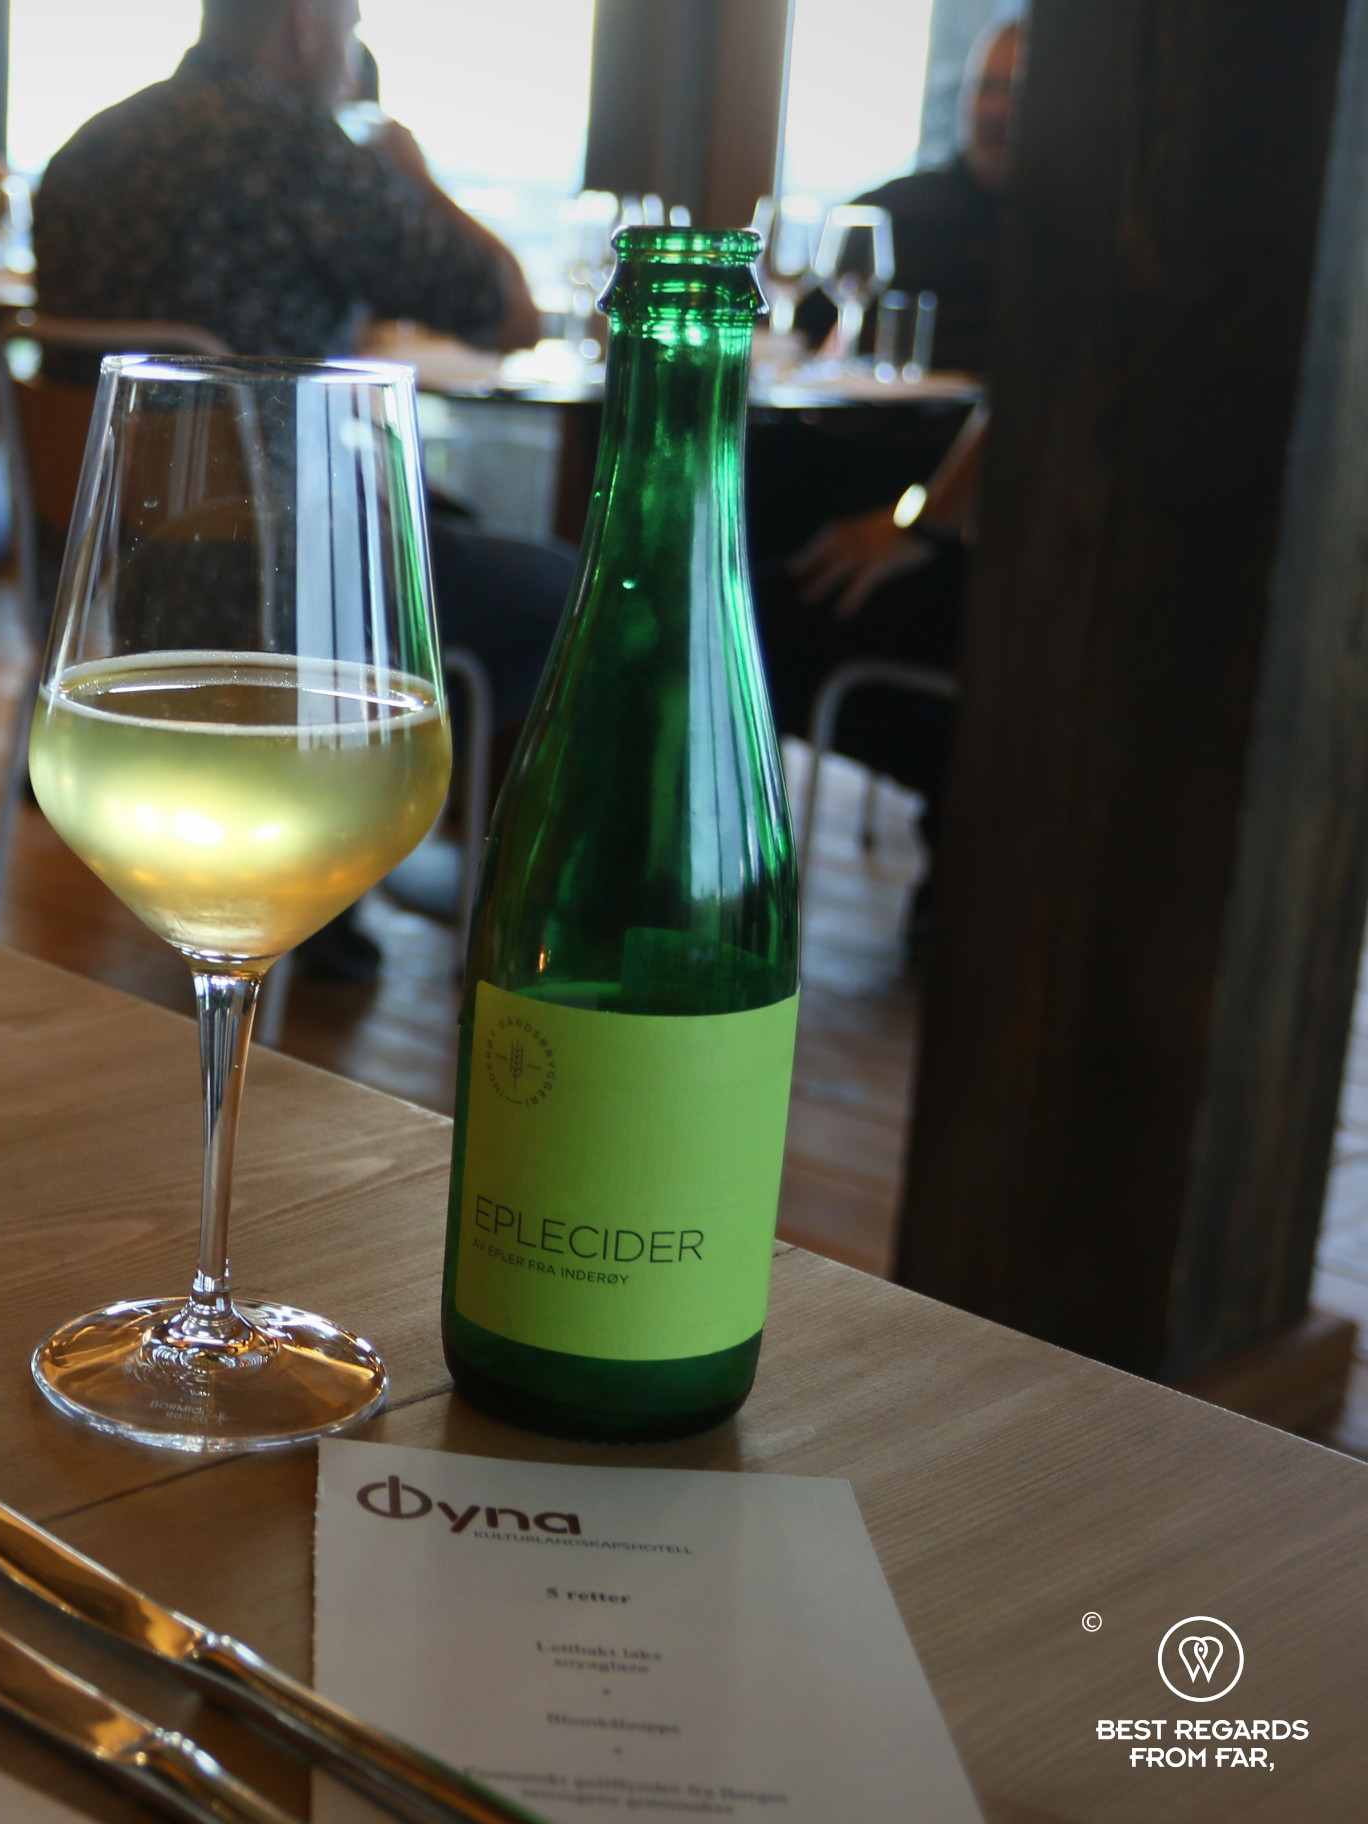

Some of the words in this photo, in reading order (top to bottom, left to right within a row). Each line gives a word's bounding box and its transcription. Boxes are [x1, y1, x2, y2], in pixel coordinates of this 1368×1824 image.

[475, 1194, 705, 1264] EPLECIDER
[472, 1238, 486, 1251] AV
[487, 1245, 525, 1268] EPLER
[527, 1259, 556, 1276] FRA
[560, 1267, 630, 1286] INDERØY
[473, 1530, 693, 1556] KULTURLANDSKAPSHOTELL
[565, 1589, 631, 1604] retter
